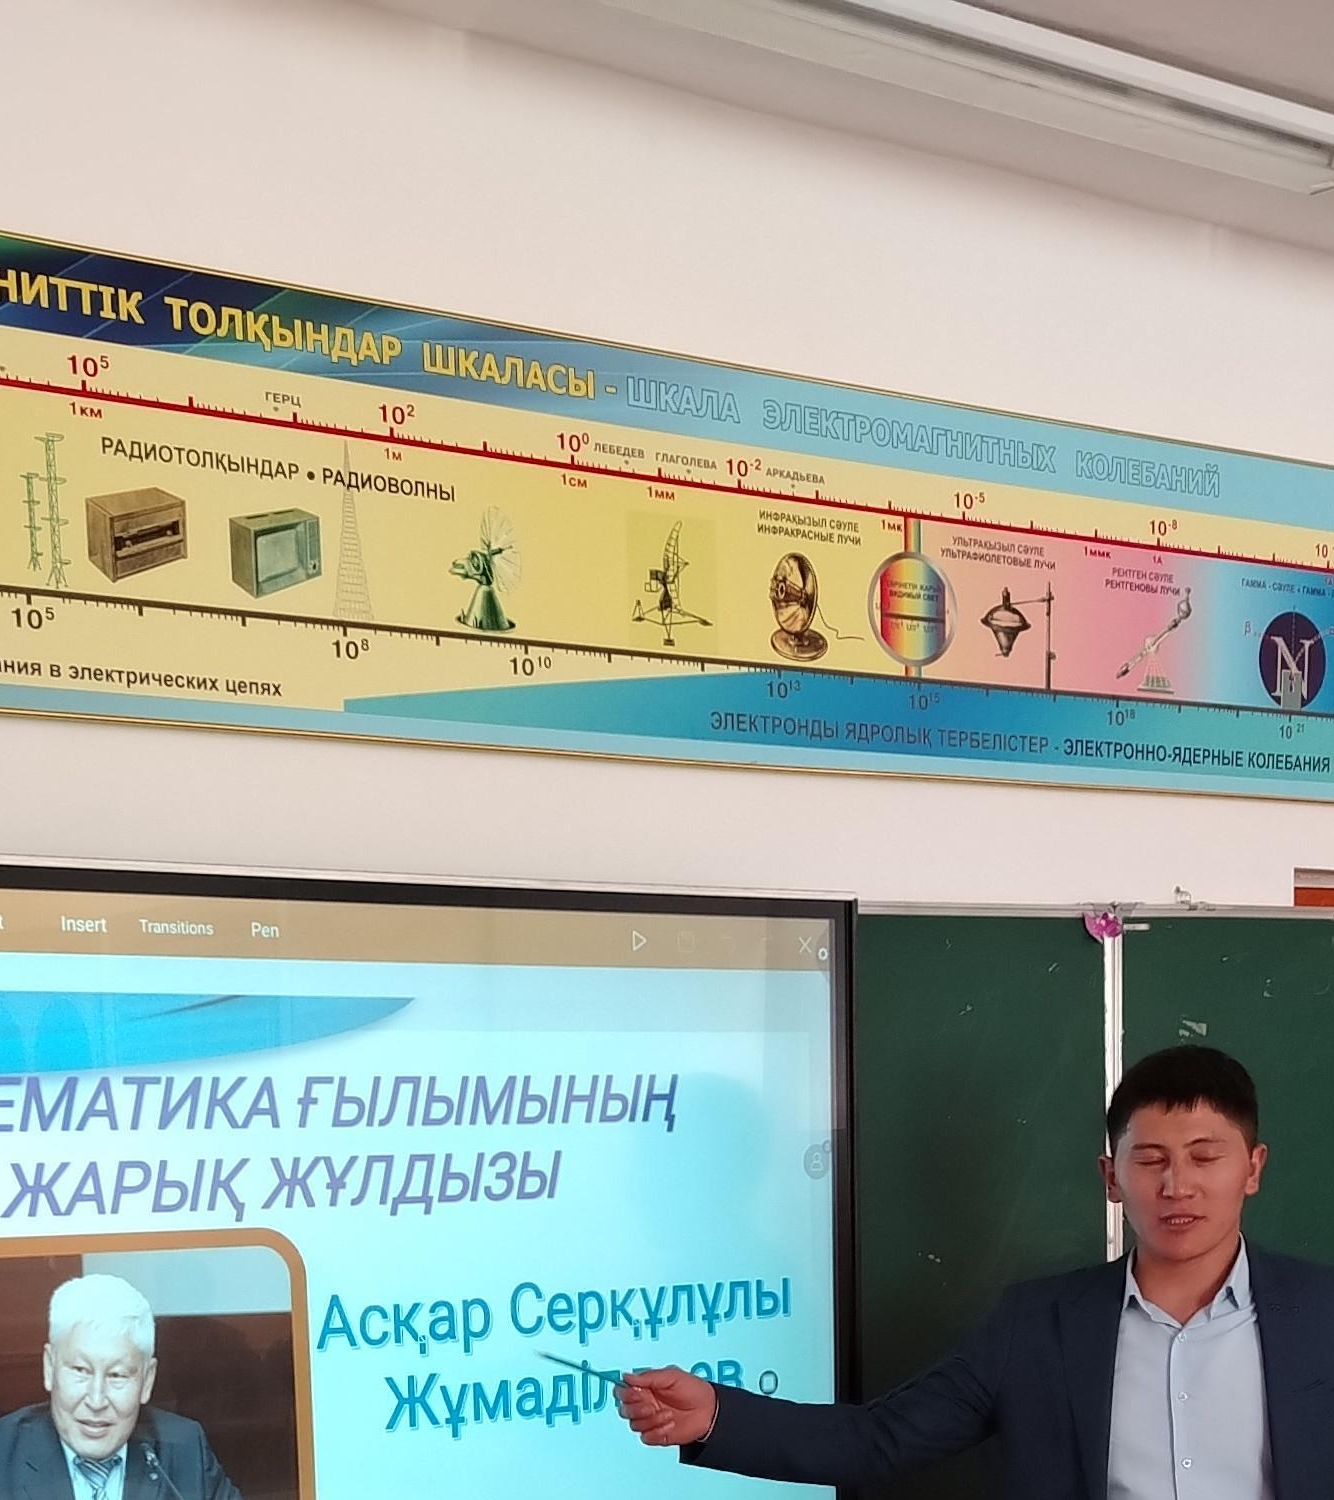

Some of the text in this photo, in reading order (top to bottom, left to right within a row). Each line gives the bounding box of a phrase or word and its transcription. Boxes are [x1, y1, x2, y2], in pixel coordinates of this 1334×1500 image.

[163, 295, 403, 366] ТОЛҚЫНДАР
[421, 341, 596, 399] ШКАЛАСЫ
[626, 376, 740, 424] ШКАЛА
[762, 400, 1057, 474] ЭЛЕКТРОМАГНИТНЫХ
[1075, 449, 1221, 498] КОЛЕБАНИЙ
[265, 391, 302, 408] ГЕРЦ
[101, 435, 456, 502] РАДИОТОЛҚЫНДАР РАДИОВОЛНЫ
[594, 441, 645, 460] ЛЕБЕДЕВ
[757, 523, 861, 546] ИНФРАКРАСНЫЕ ЛУЧИ
[1033, 560, 1056, 571] ЛУЧИ
[49, 663, 61, 677] в
[68, 664, 219, 693] электрических
[225, 678, 283, 699] цепях
[710, 711, 839, 741] ЭЛЕКТРОНДЫ
[845, 723, 933, 749] ЯДРОЛЫҚ
[938, 730, 1049, 755] ТЕРБЕЛІСТЕР
[1063, 738, 1244, 769] ЭЛЕКТРОННО-ЯДЕРНЫЕ
[1247, 750, 1331, 773] КОЛЕБАНИЯ
[60, 915, 107, 934] Insert
[139, 917, 214, 937] Transitions
[251, 921, 280, 939] Pen
[297, 1073, 678, 1132] ҒЫЛЫМЫНЫҢ
[0, 1150, 562, 1221] ЖАРЫҚ ЖҰЛДЫЗЫ
[317, 1275, 791, 1355] Асқар Серқұлұлы
